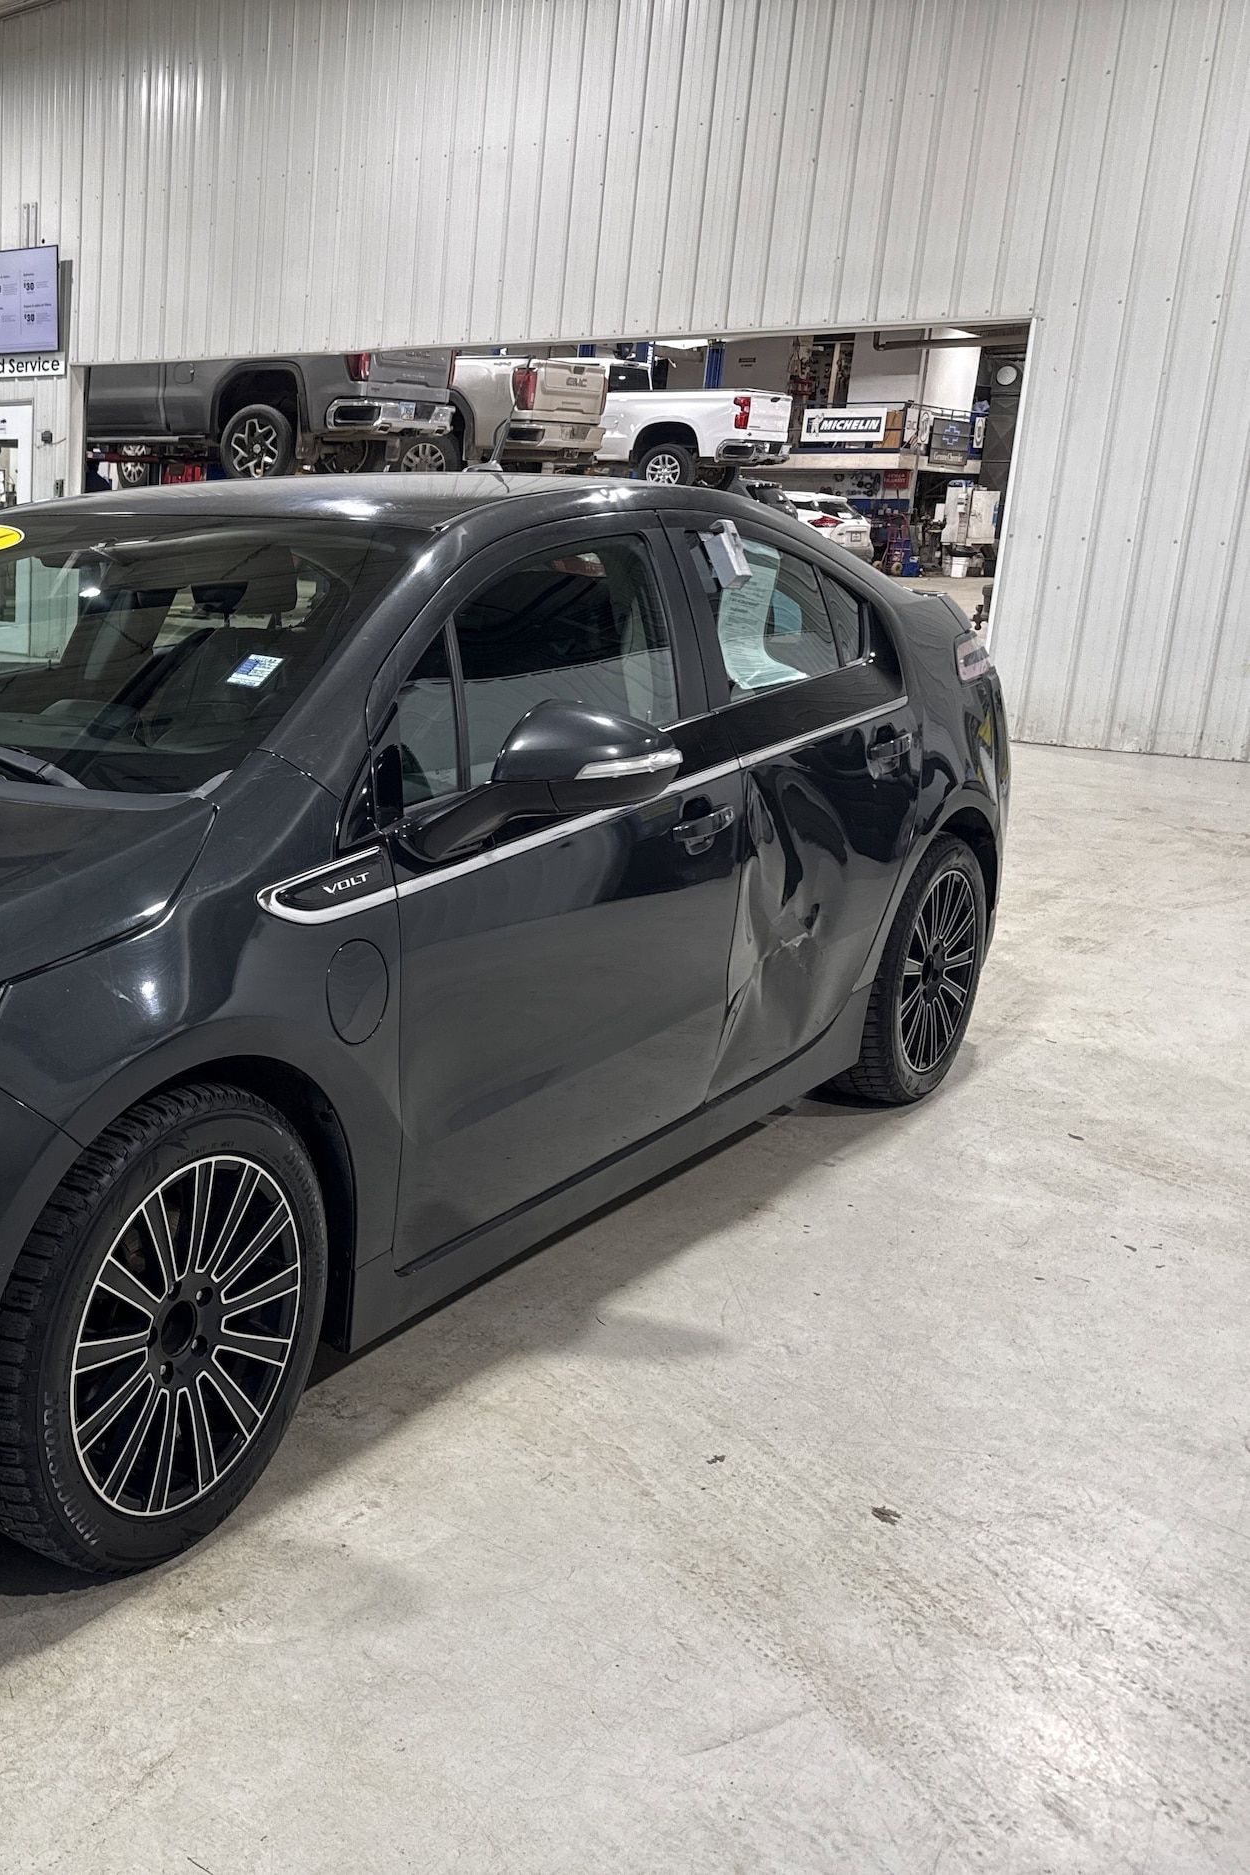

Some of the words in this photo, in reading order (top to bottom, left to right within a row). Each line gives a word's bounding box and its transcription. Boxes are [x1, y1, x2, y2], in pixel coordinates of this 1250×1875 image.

[23, 281, 35, 291] $30
[24, 313, 35, 322] $30
[8, 356, 60, 374] Service
[820, 418, 881, 431] MICHELIN
[322, 872, 370, 895] VOLT
